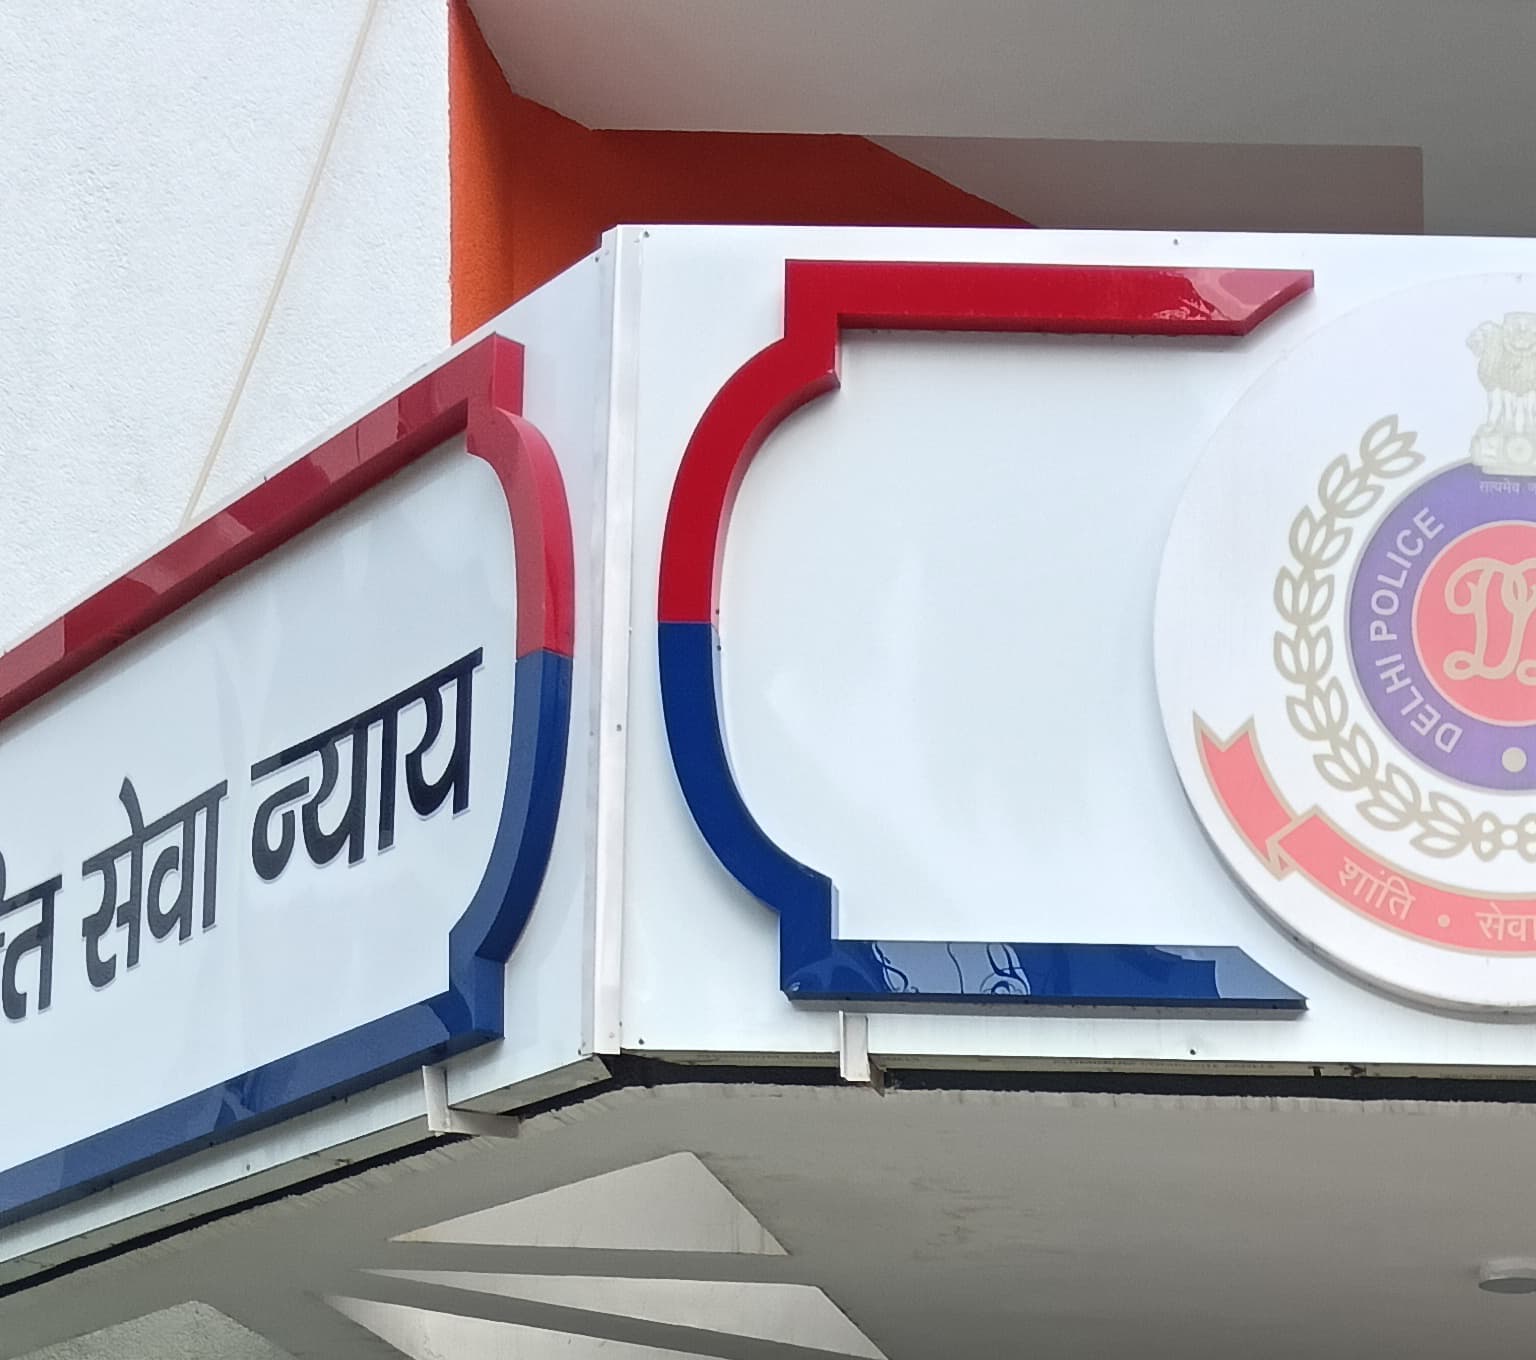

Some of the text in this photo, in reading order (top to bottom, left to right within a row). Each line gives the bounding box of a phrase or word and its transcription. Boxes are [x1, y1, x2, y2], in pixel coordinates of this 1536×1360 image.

[1369, 506, 1463, 753] DELHI POLICE
[81, 777, 229, 988] सेवा
[250, 646, 484, 881] न्याय
[1338, 857, 1416, 921] शांति
